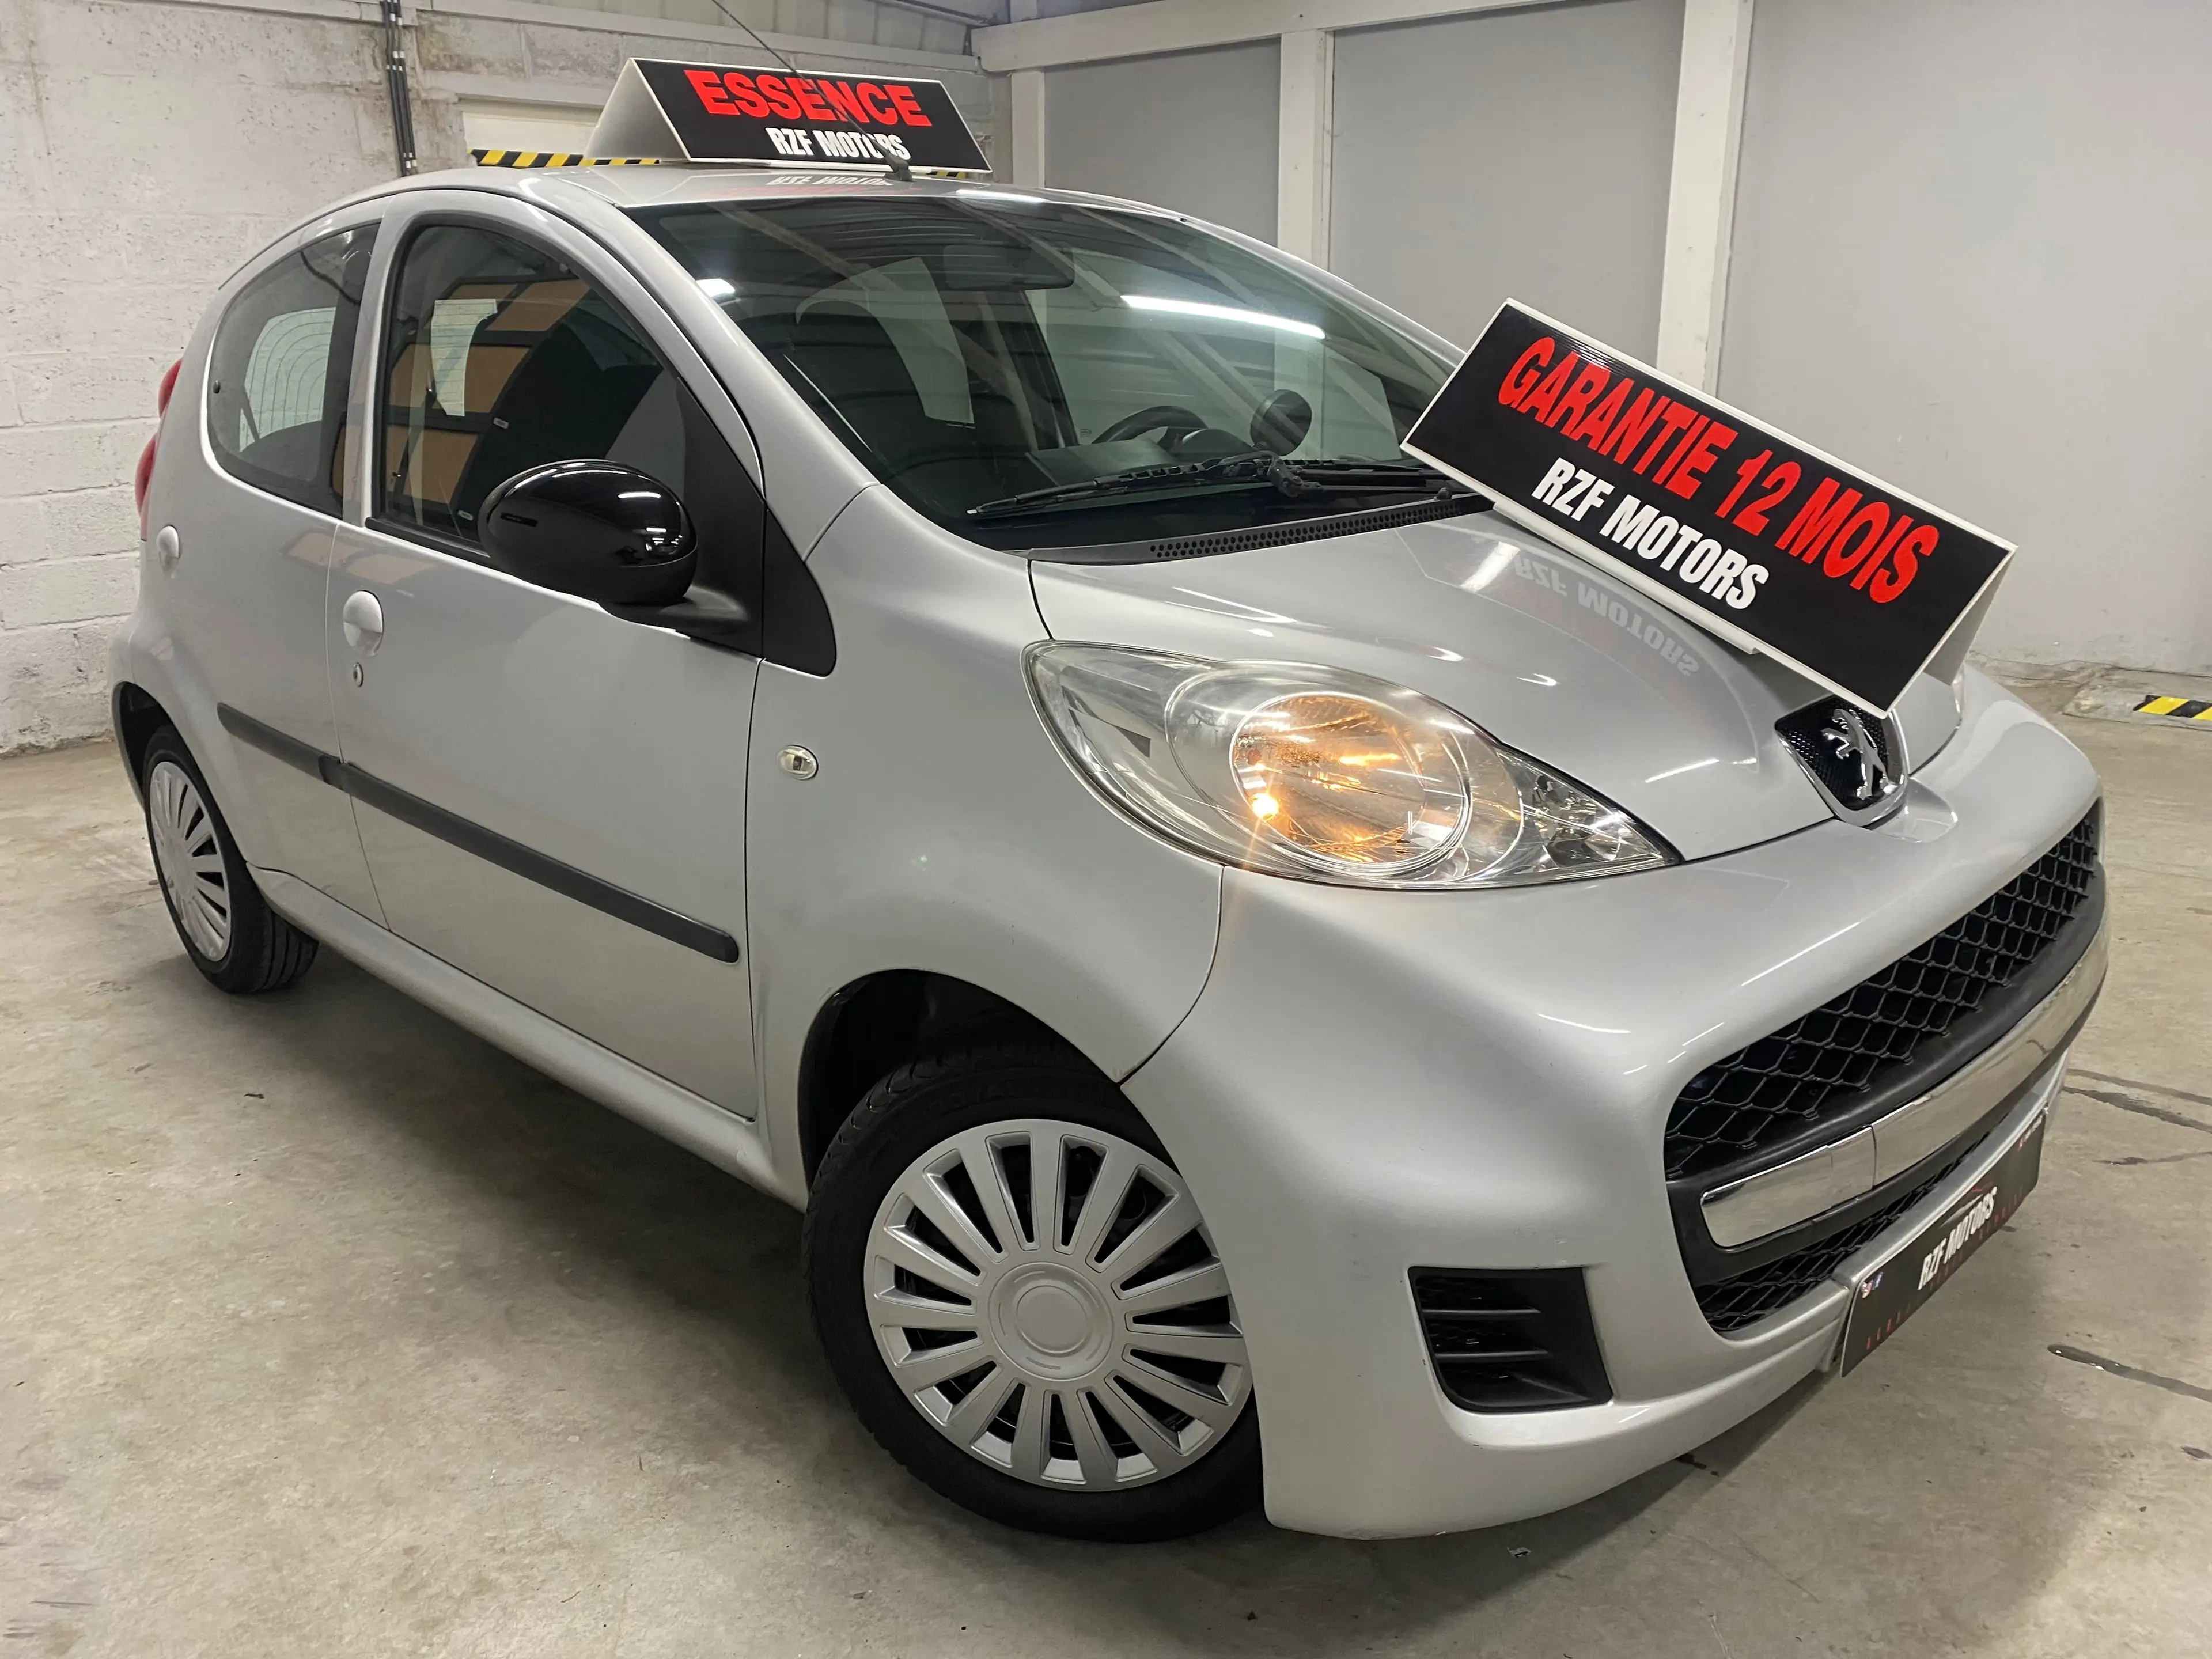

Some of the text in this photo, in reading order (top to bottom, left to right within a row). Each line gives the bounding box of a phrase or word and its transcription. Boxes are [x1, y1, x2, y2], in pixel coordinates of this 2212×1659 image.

[684, 69, 932, 127] ESSENCE
[765, 127, 815, 156] RZF
[1498, 336, 1939, 603] GARANTIE 12 MOIS
[1531, 457, 1769, 609] RZF MOTORS
